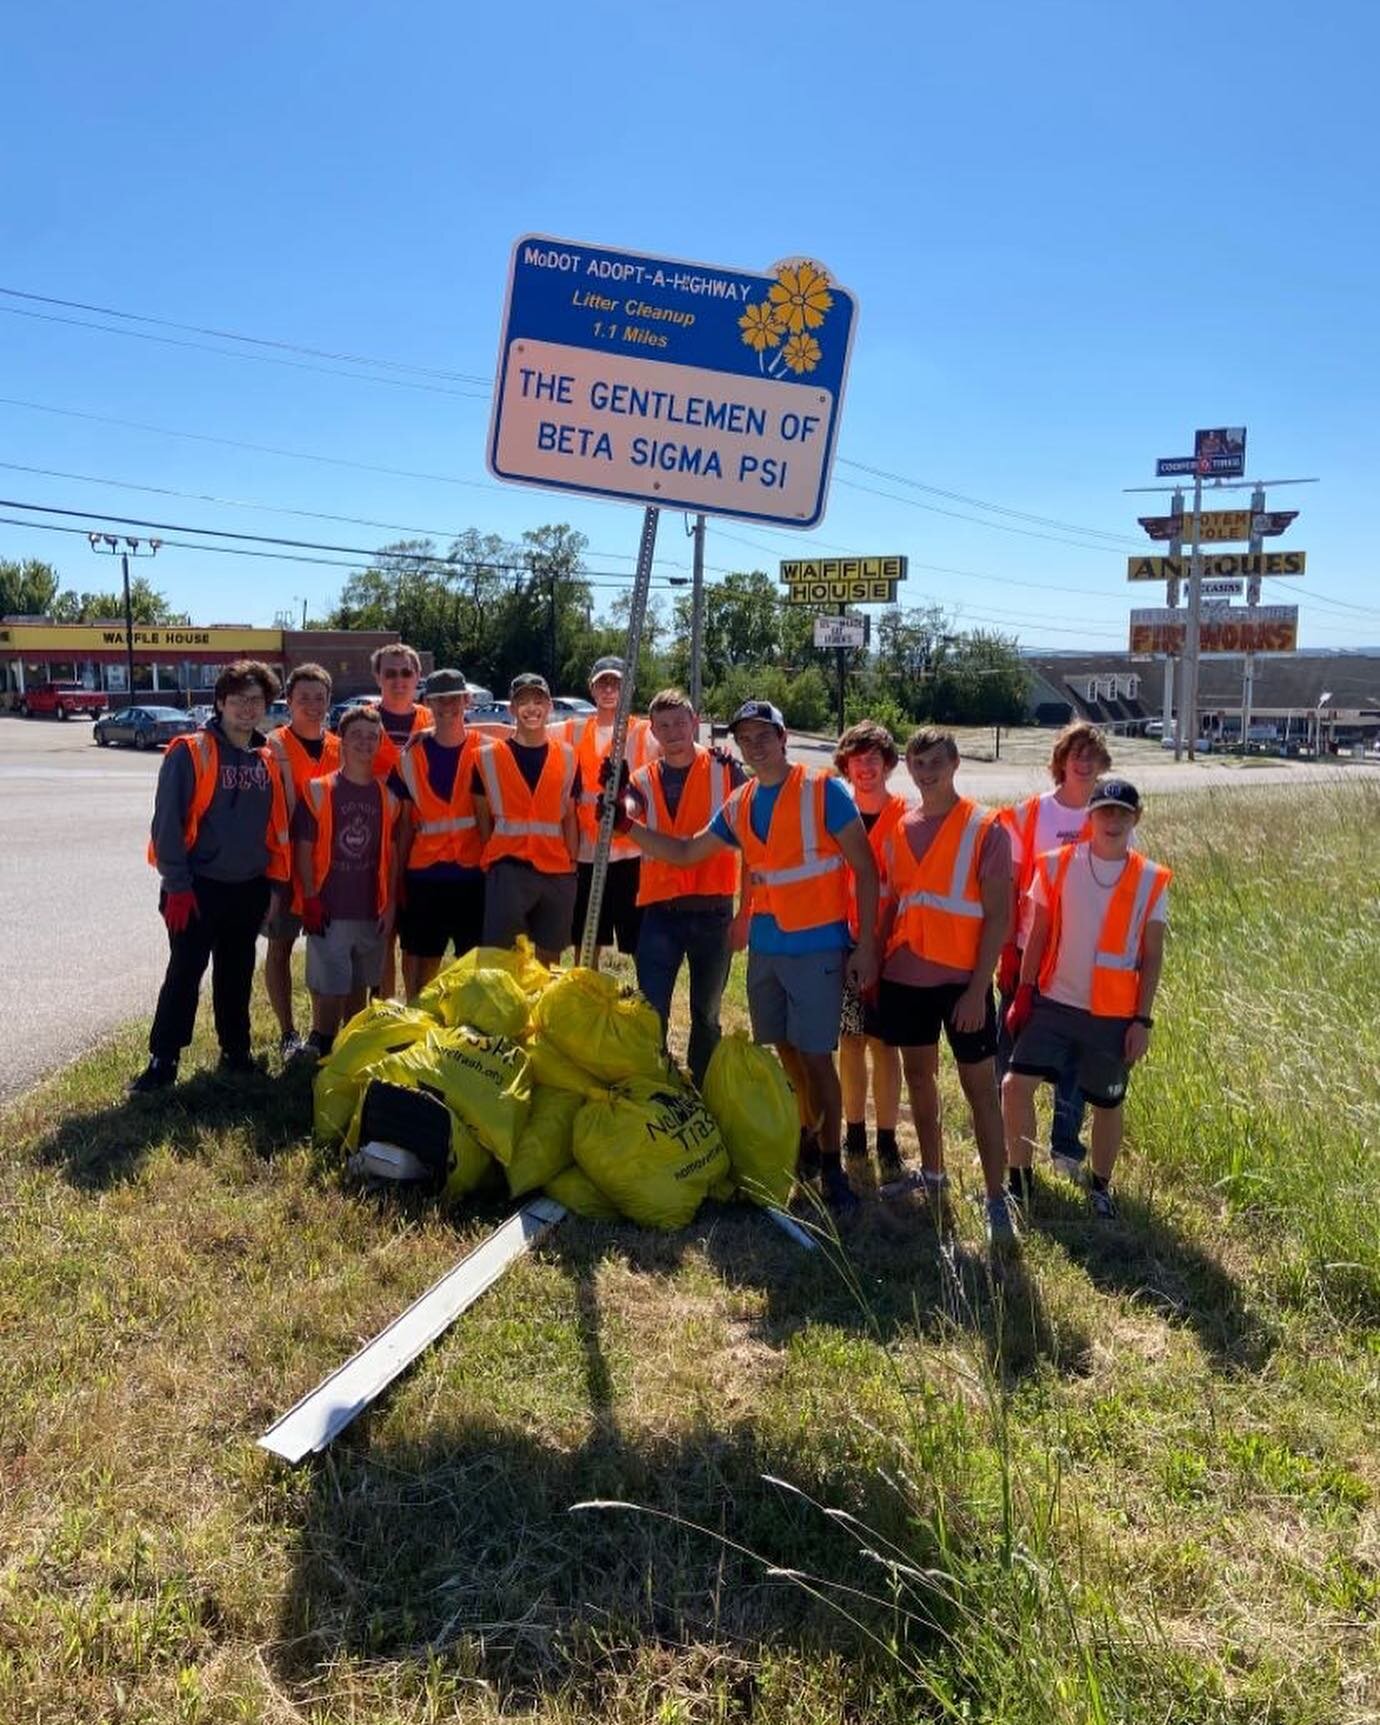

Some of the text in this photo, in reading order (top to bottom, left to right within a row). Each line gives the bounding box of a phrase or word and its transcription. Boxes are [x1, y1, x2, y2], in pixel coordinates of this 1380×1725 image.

[587, 260, 751, 301] ADOPT-A-HIGHWAY
[572, 290, 696, 327] Litter Cleanup
[593, 323, 668, 348] 1.1 Miles
[520, 369, 820, 443] THE GENTLEMEN OF
[538, 422, 788, 488] BETA SIGMA PSI
[1197, 527, 1240, 539] OLE
[783, 561, 898, 579] WAFFLE
[793, 584, 887, 599] HOUSE
[103, 633, 209, 644] WAFLE HOUSE
[1132, 622, 1294, 653] FIRWORKS
